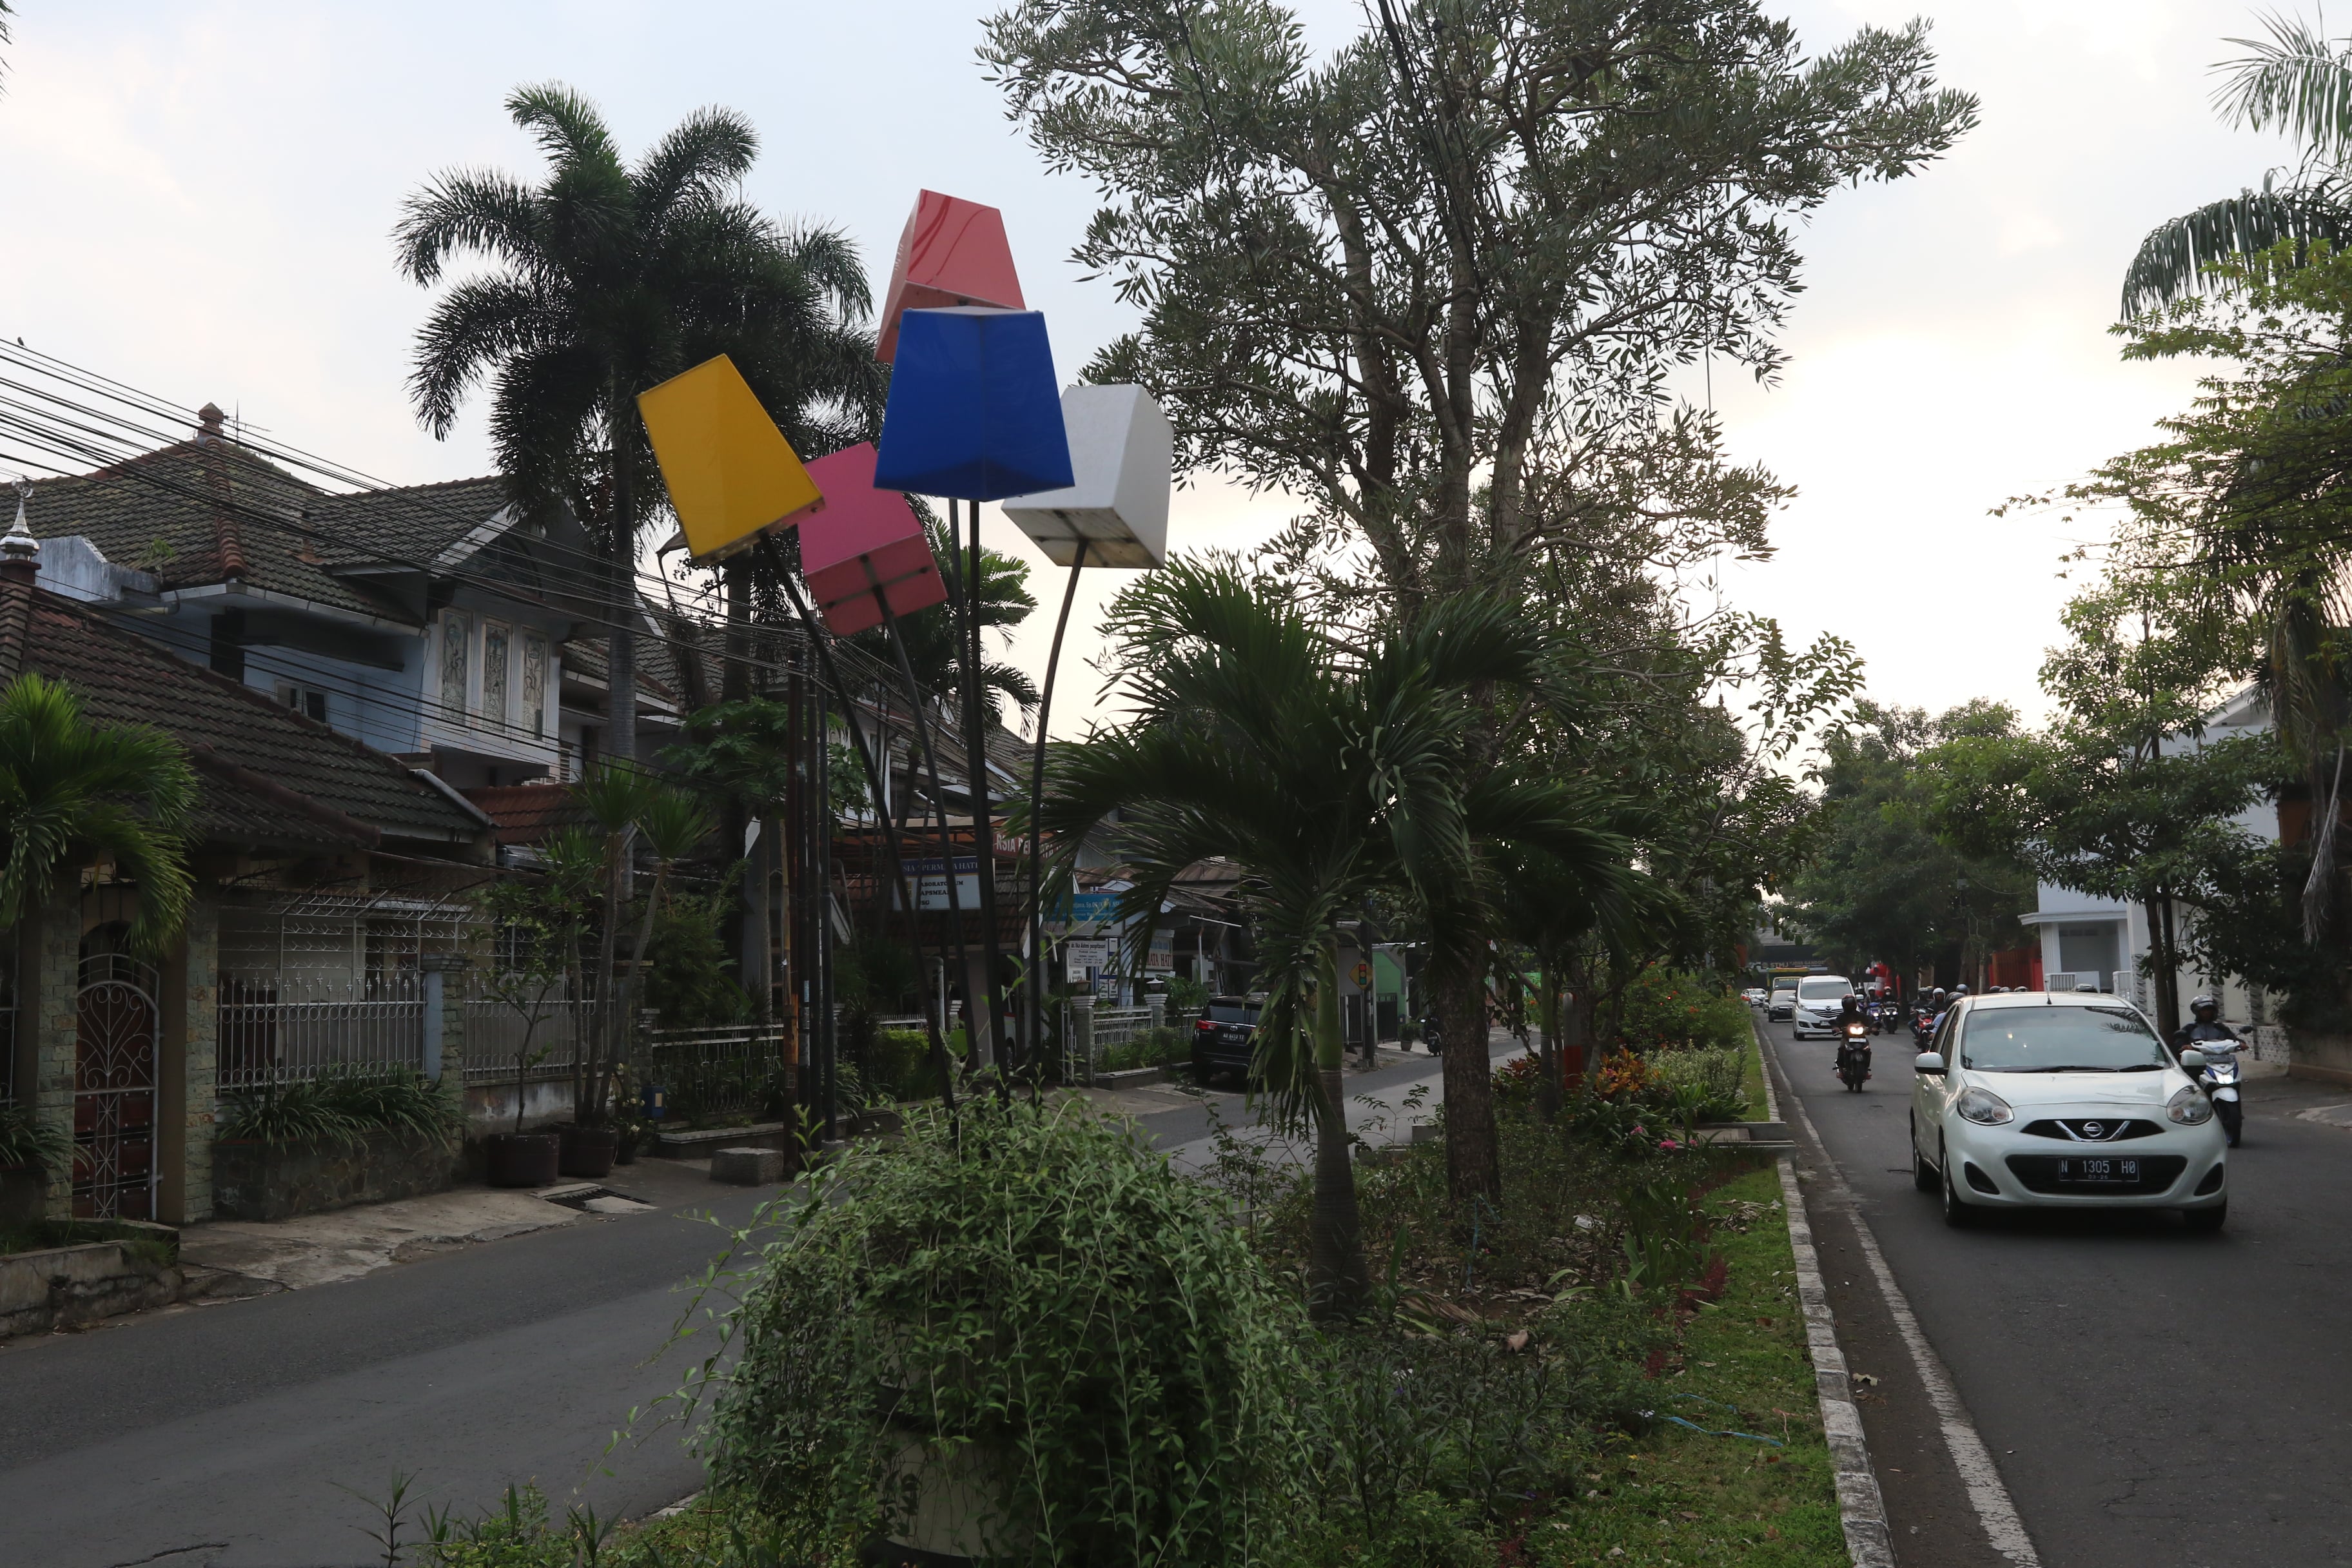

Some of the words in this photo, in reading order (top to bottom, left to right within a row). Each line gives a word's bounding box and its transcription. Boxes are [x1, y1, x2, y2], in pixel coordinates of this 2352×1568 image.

[959, 861, 978, 870] HATI
[2061, 1160, 2068, 1173] N
[2082, 1160, 2110, 1173] 1305
